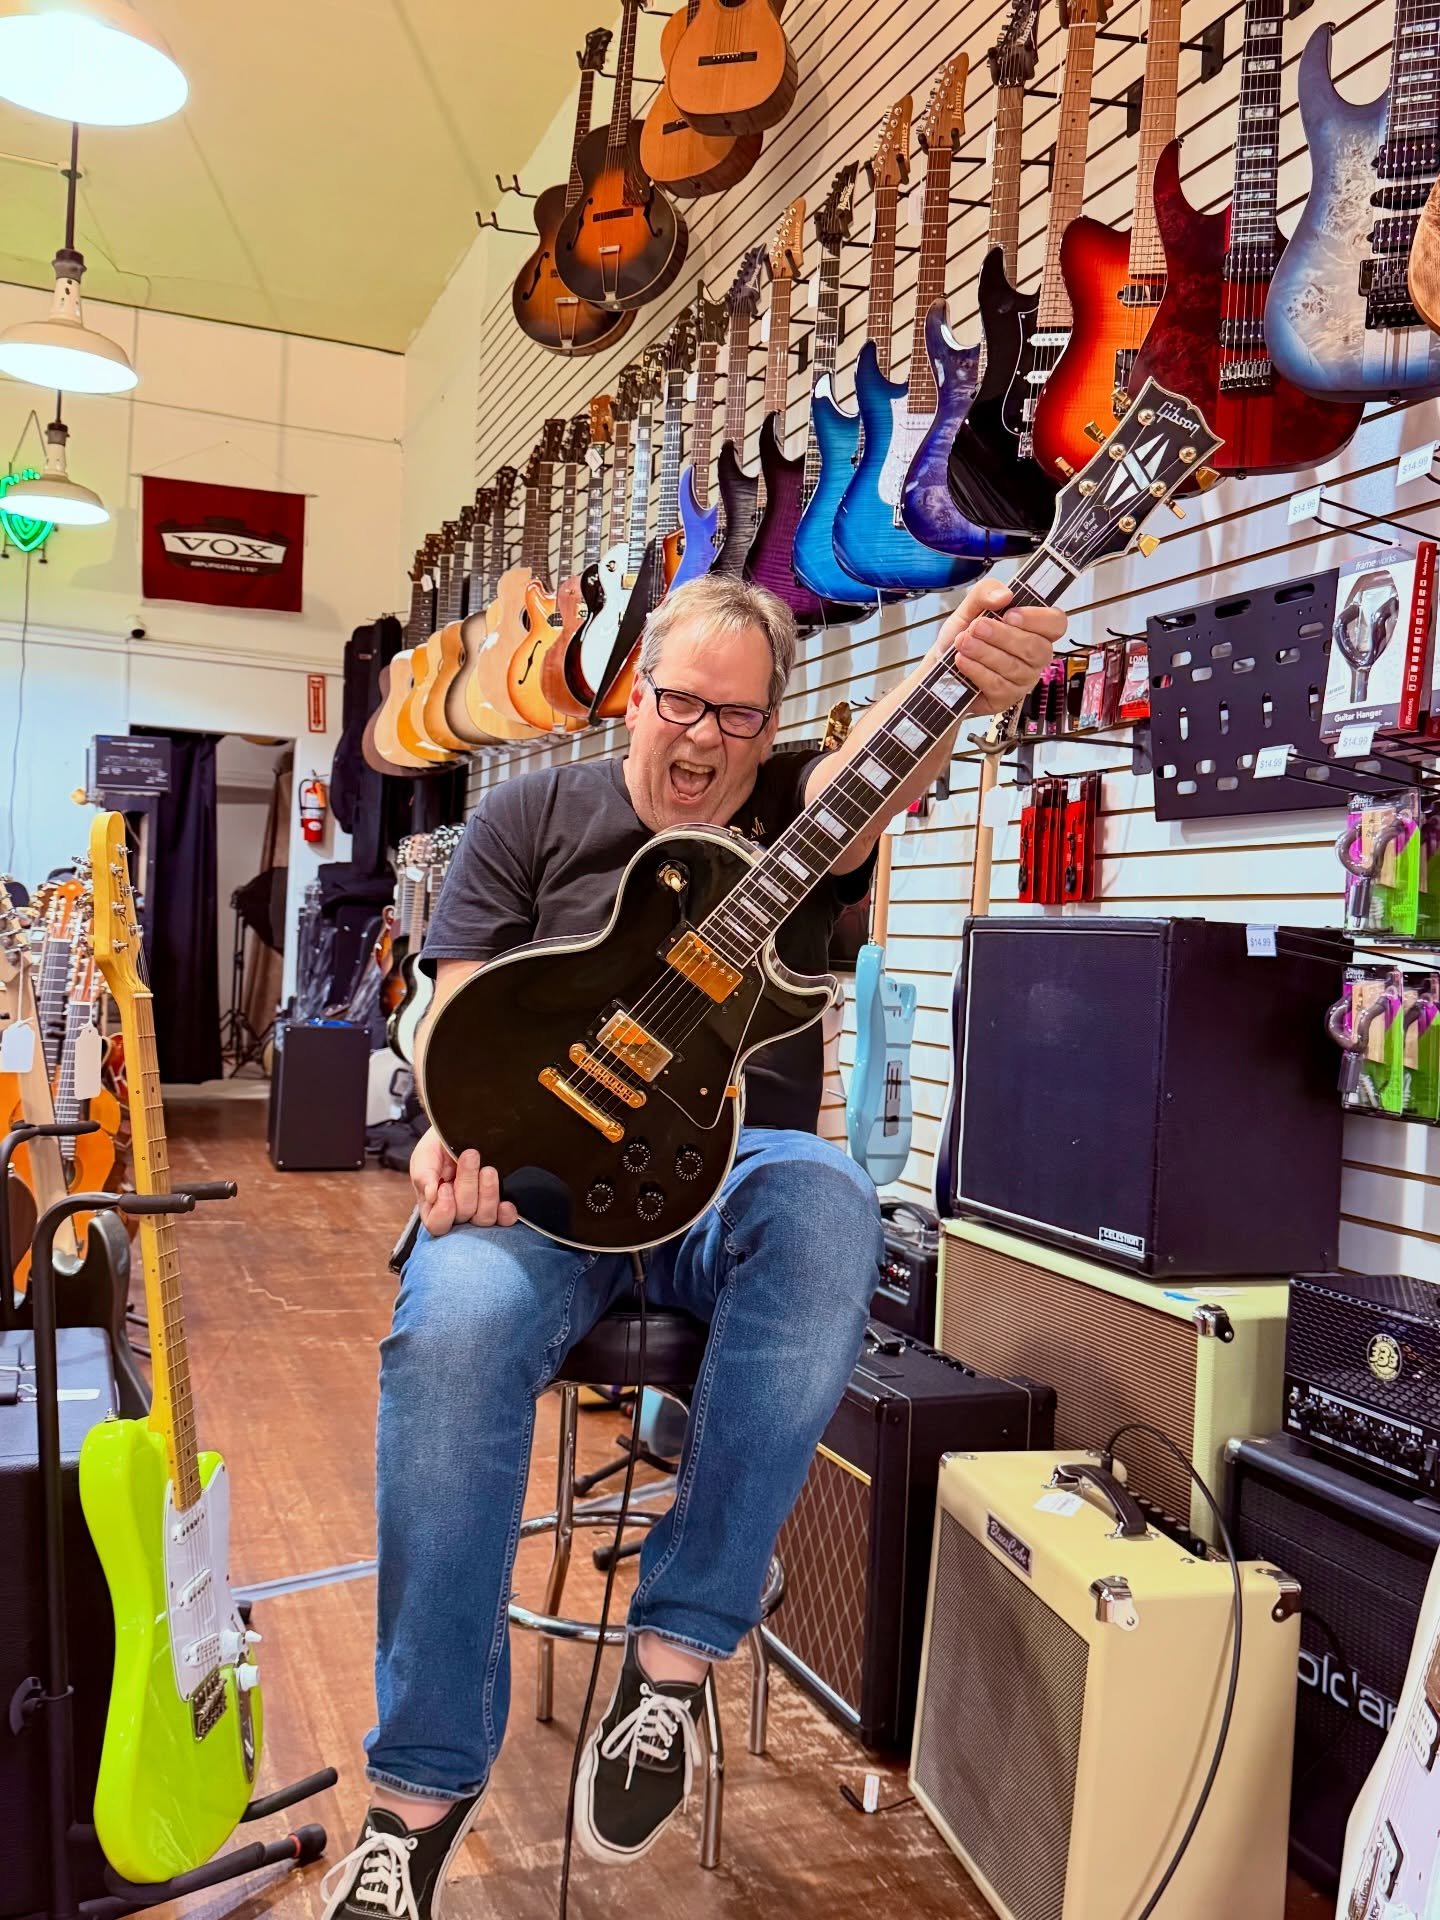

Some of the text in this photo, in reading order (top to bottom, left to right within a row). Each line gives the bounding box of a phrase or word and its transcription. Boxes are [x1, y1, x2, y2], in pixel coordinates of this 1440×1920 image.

[1015, 10, 1037, 45] Ibanez
[951, 81, 964, 120] Ibanez
[1156, 401, 1201, 438] Gibson
[1402, 456, 1429, 475] $14.99
[1292, 502, 1316, 516] $14.99
[1082, 523, 1099, 541] CUSTOM
[172, 534, 274, 561] VOX
[1334, 709, 1383, 723] Guitar Hanger
[1342, 736, 1369, 748] $14.99
[1259, 757, 1283, 769] $14.99
[1250, 937, 1271, 947] $14.99
